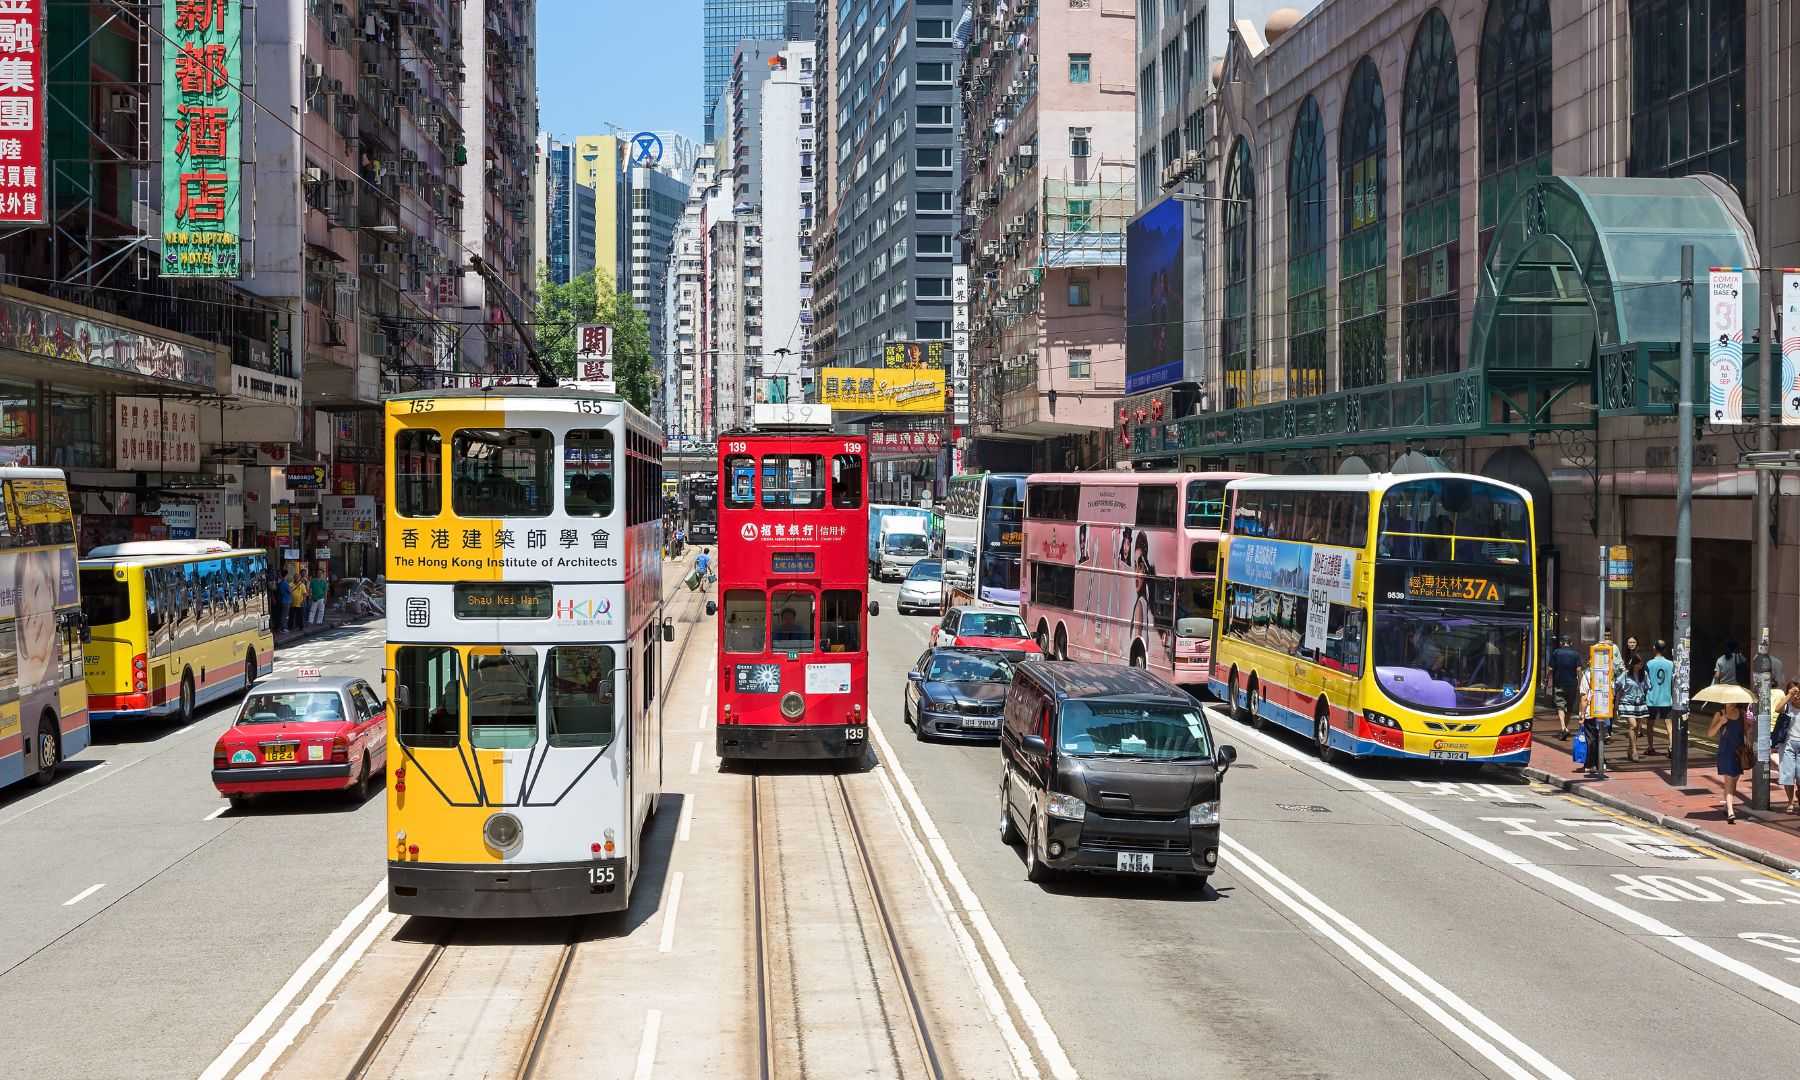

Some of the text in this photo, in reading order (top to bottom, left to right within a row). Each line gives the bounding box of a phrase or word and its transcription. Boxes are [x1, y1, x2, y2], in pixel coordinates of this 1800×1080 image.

[176, 0, 228, 220] 新都酒店
[166, 232, 236, 246] NEW CAPITAL
[181, 252, 214, 264] HOTEL
[826, 377, 874, 393] 日本城
[409, 400, 602, 414] 155 155
[872, 432, 940, 445] 潮興魚蛋粉
[729, 442, 861, 452] 139 139
[761, 524, 846, 536] 招商銀行 信用卡
[401, 528, 610, 549] 香港建築師學會
[394, 557, 618, 569] The Hong Kong Institute of Architects
[1409, 575, 1499, 600] 經薄扶林 37A
[468, 595, 492, 605] Shau
[497, 595, 515, 605] Kei
[557, 599, 613, 620] HKIA
[1657, 668, 1666, 686] 9
[844, 729, 864, 739] 139
[588, 868, 614, 883] 155
